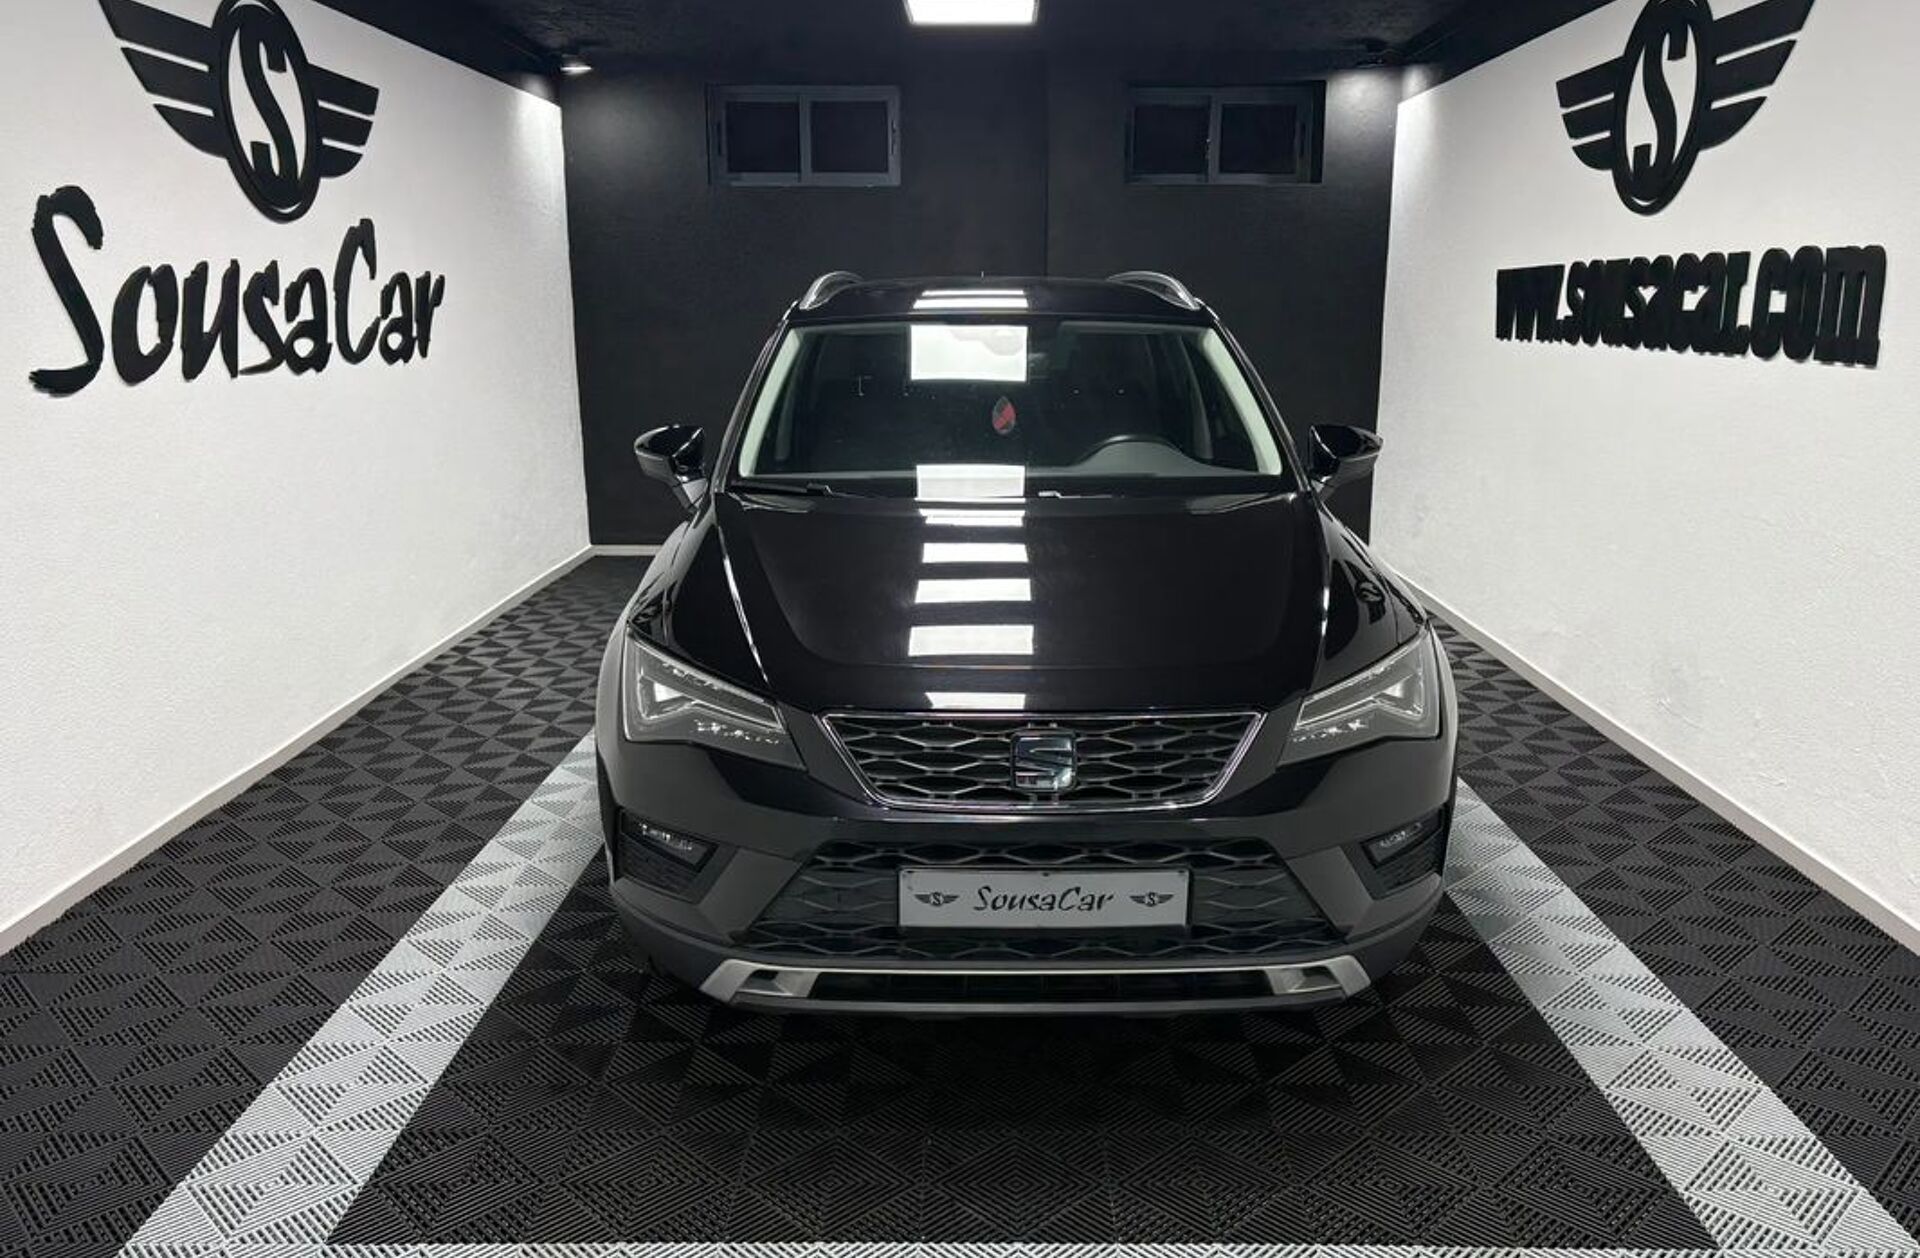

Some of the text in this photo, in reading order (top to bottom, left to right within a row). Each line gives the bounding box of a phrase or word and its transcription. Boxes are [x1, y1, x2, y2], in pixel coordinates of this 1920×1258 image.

[28, 185, 445, 397] SousaCar
[1496, 245, 1887, 369] www.sousacar.com
[973, 886, 1114, 911] SousaCar
